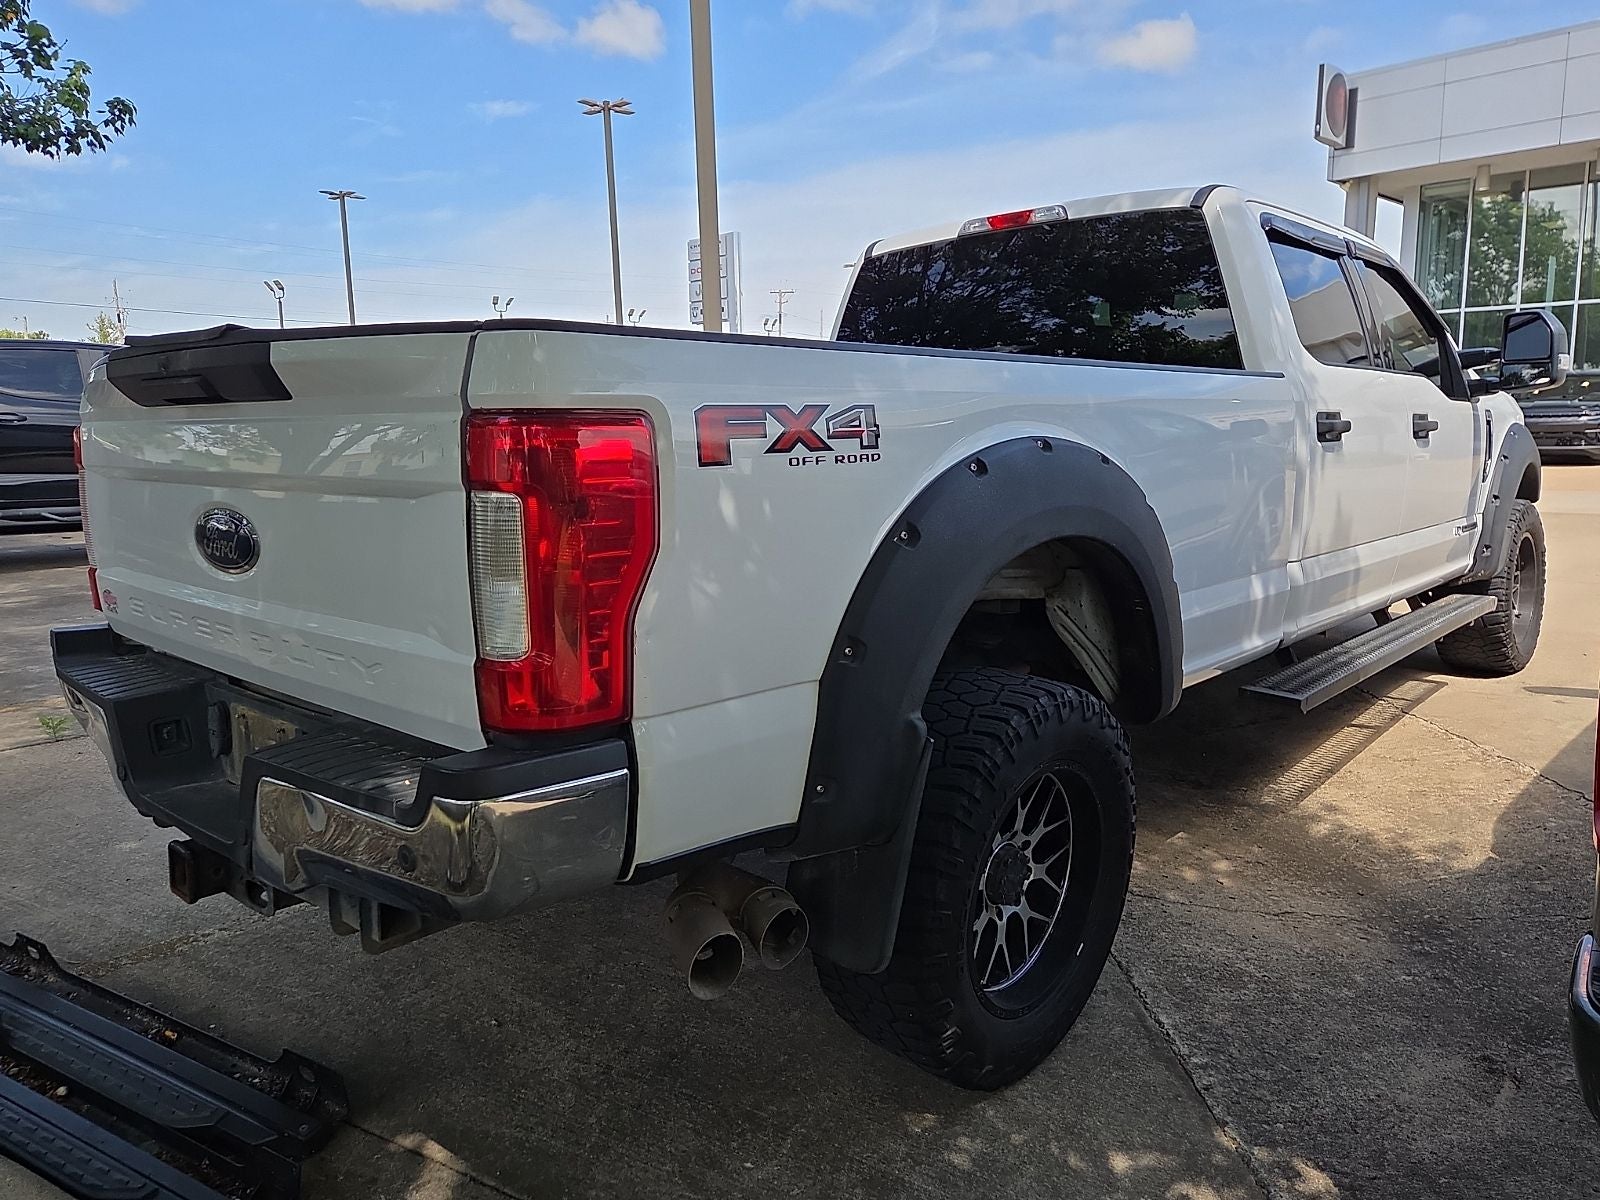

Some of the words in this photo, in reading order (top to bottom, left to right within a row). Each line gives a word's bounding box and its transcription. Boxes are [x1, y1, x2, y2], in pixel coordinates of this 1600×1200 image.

[693, 403, 880, 468] FX4
[788, 455, 827, 467] OFF
[834, 453, 882, 465] ROAD
[203, 525, 239, 559] Ford
[128, 596, 240, 645] SUPER
[249, 630, 384, 685] DUTY
